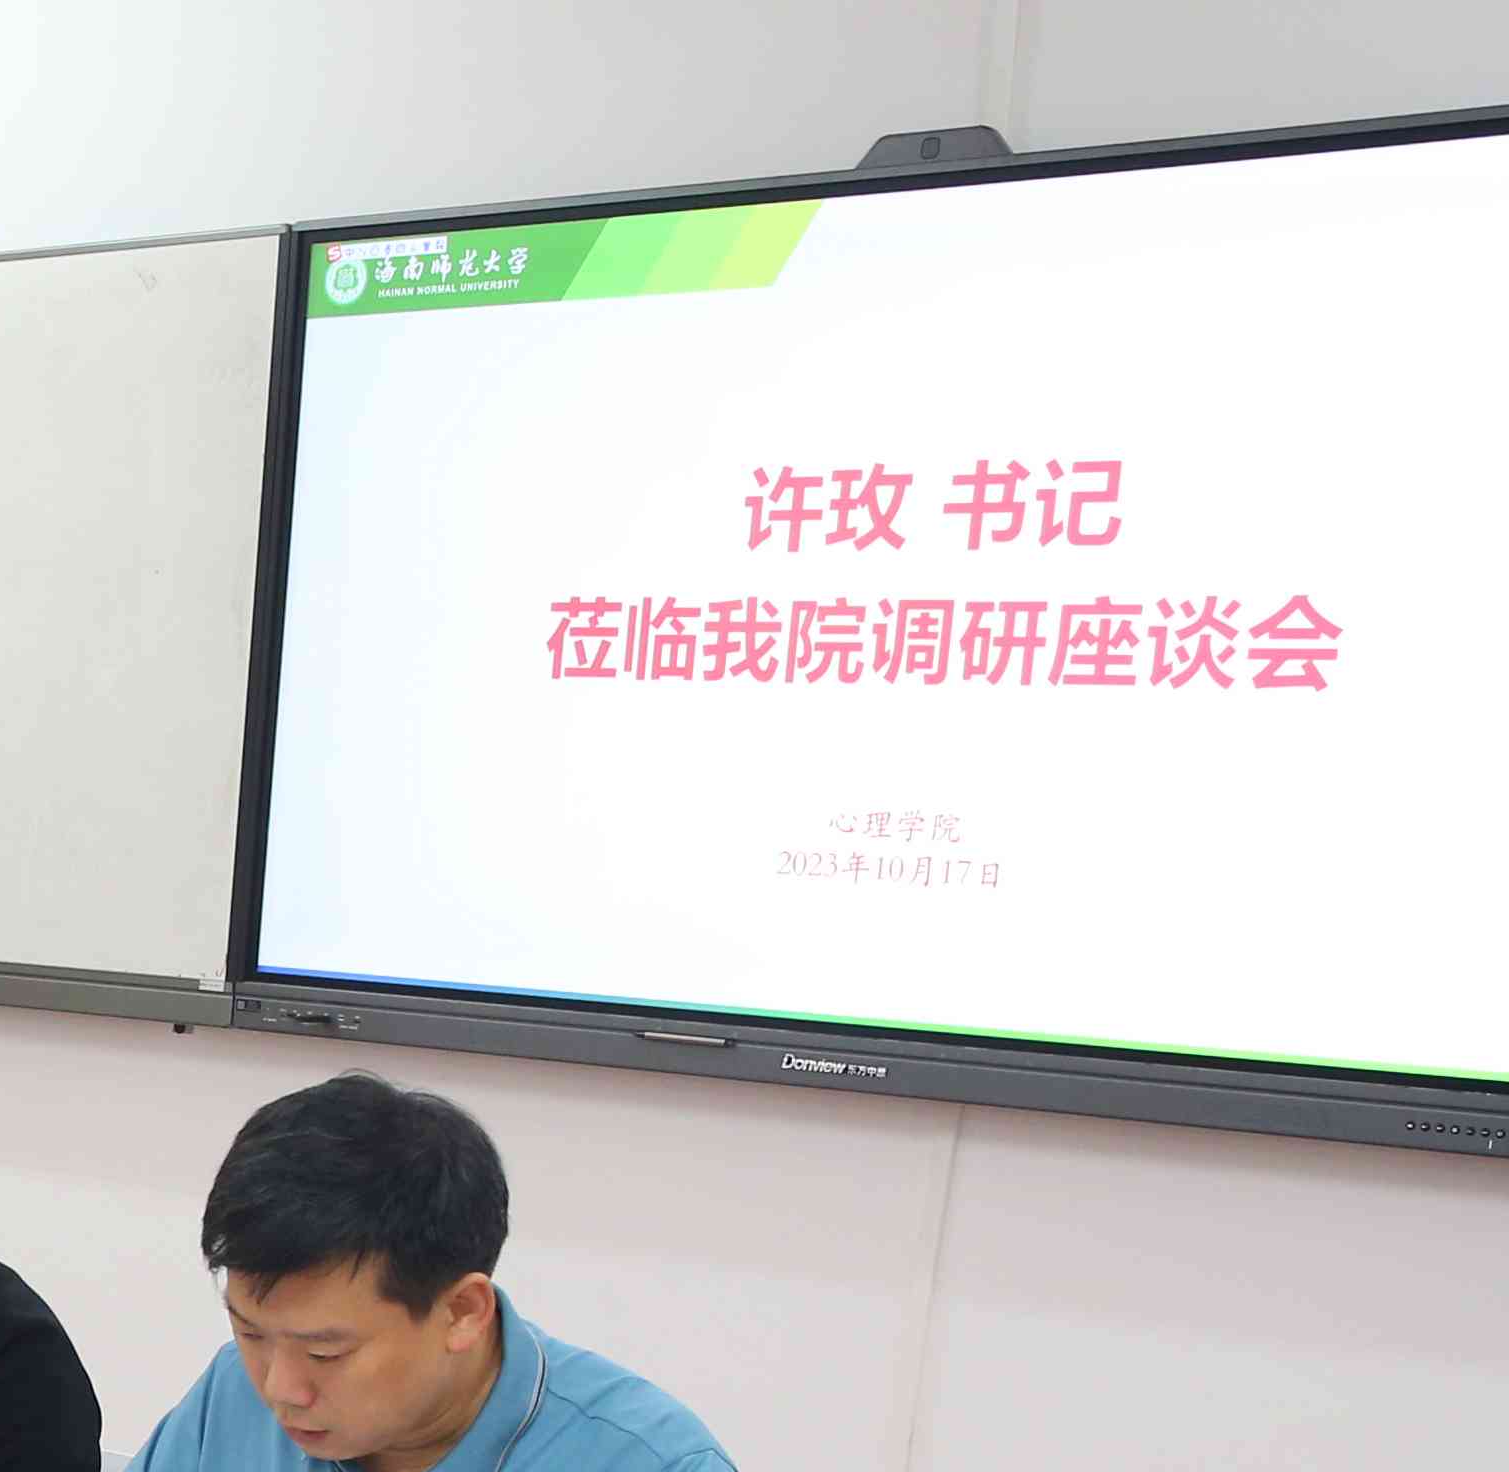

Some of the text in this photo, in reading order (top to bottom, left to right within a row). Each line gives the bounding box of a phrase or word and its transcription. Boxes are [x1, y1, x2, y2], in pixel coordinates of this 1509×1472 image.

[378, 279, 520, 298] HAINAN NORMAL UNIVERSITY
[745, 458, 1123, 553] 许玫 书记
[547, 594, 1343, 692] 莅临我院调研座谈会
[829, 810, 961, 843] 心理学院
[777, 850, 1000, 889] 2023年10月17日
[781, 1053, 846, 1074] Donview
